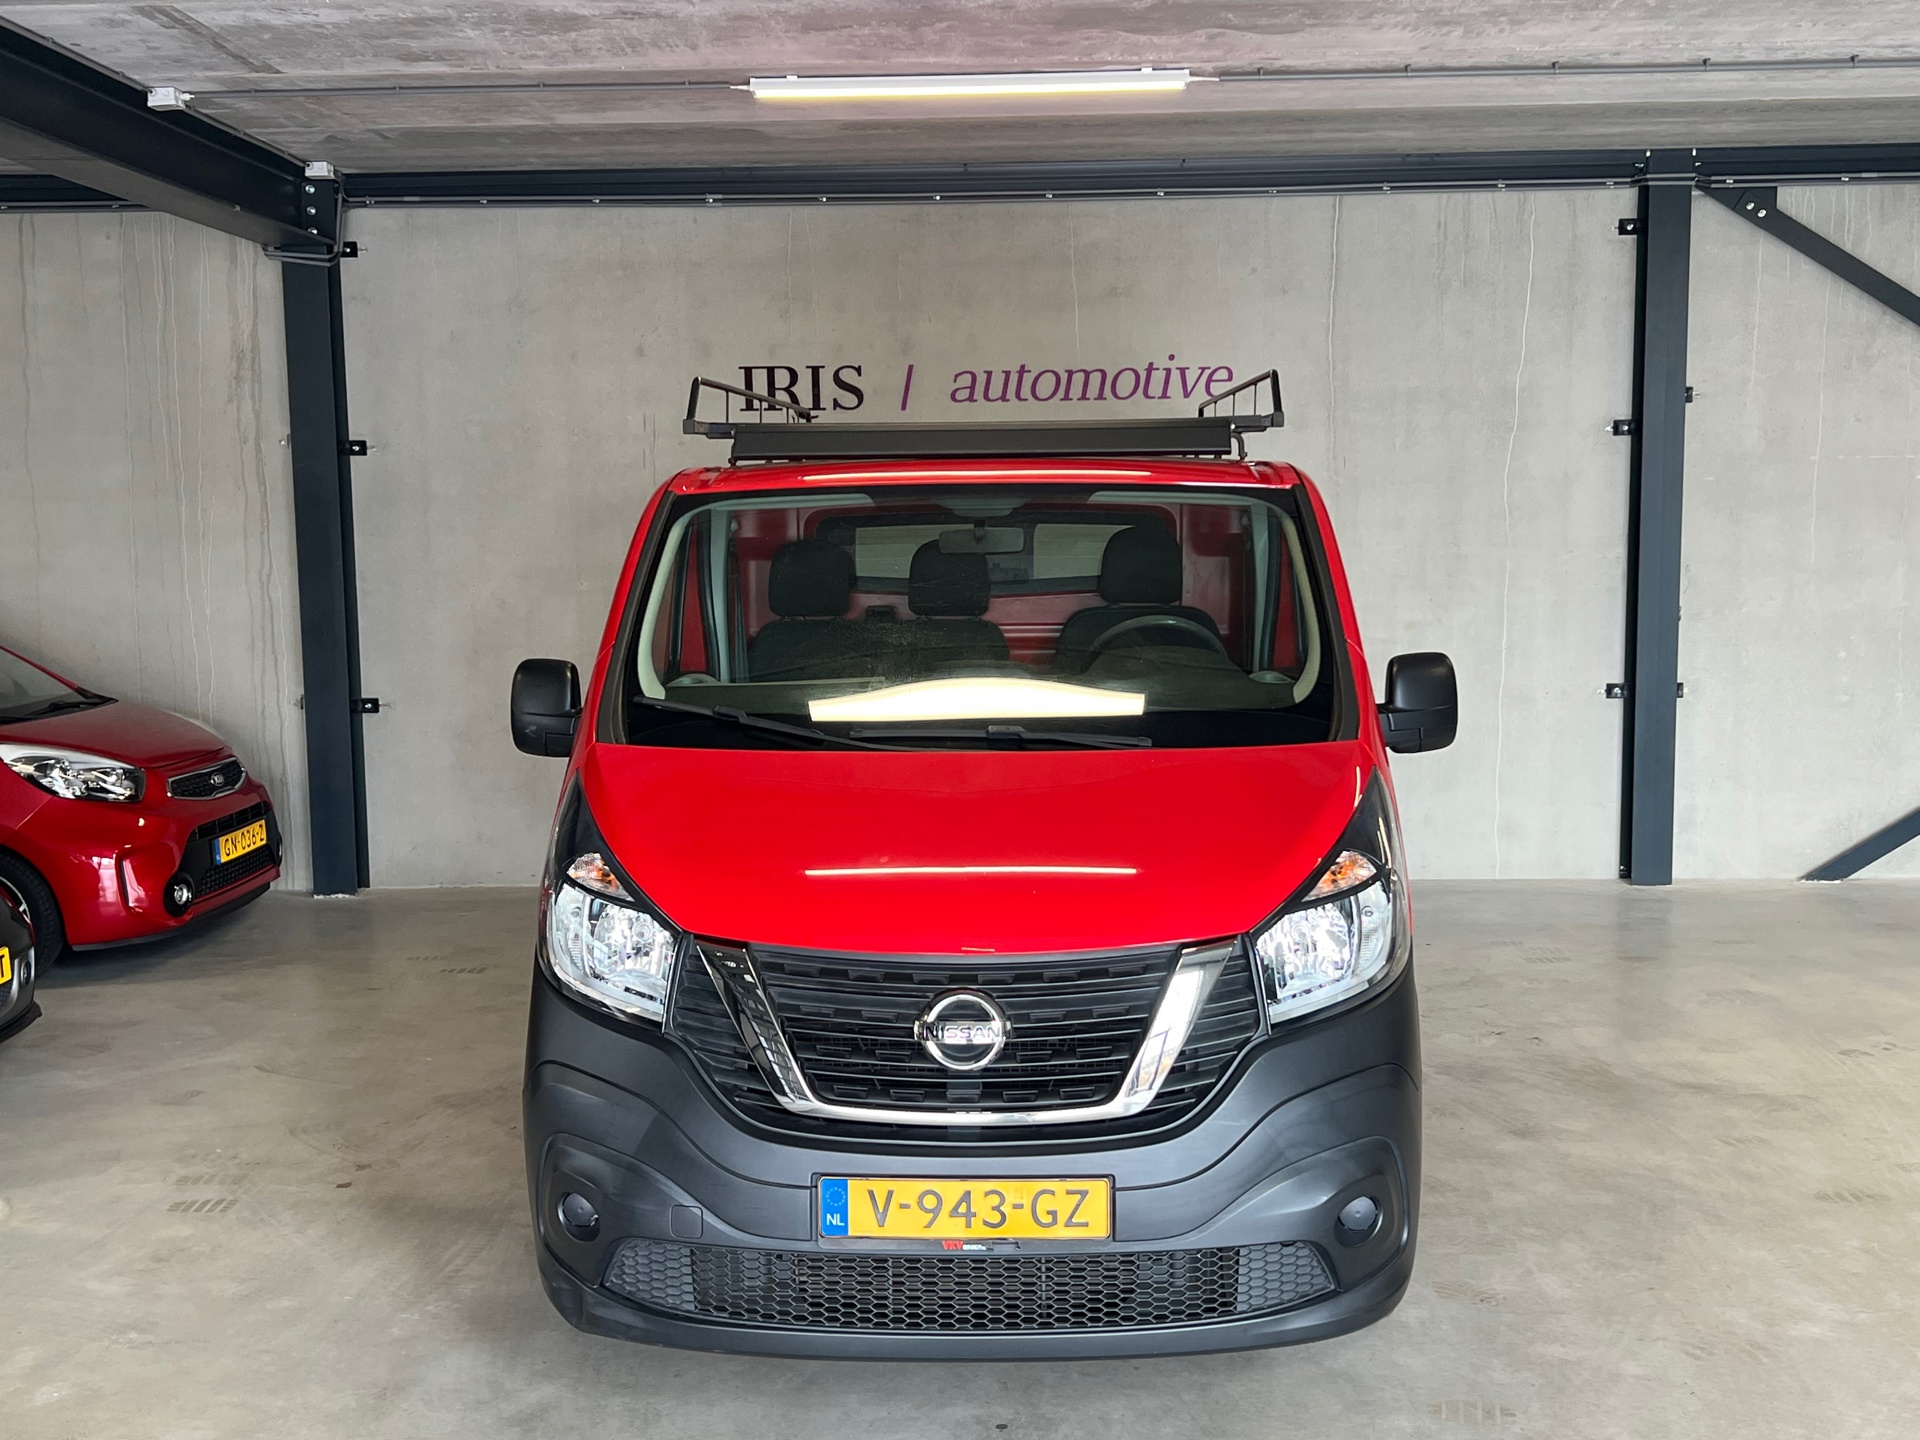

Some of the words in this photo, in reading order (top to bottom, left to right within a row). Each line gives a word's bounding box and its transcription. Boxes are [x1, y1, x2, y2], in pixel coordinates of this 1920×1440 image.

[738, 365, 864, 411] IRIS
[950, 354, 1234, 403] automotive
[224, 824, 265, 857] GN-036-Z
[924, 1025, 1001, 1039] NISSAN
[826, 1213, 845, 1226] NL
[867, 1189, 1089, 1229] V-943-GZ
